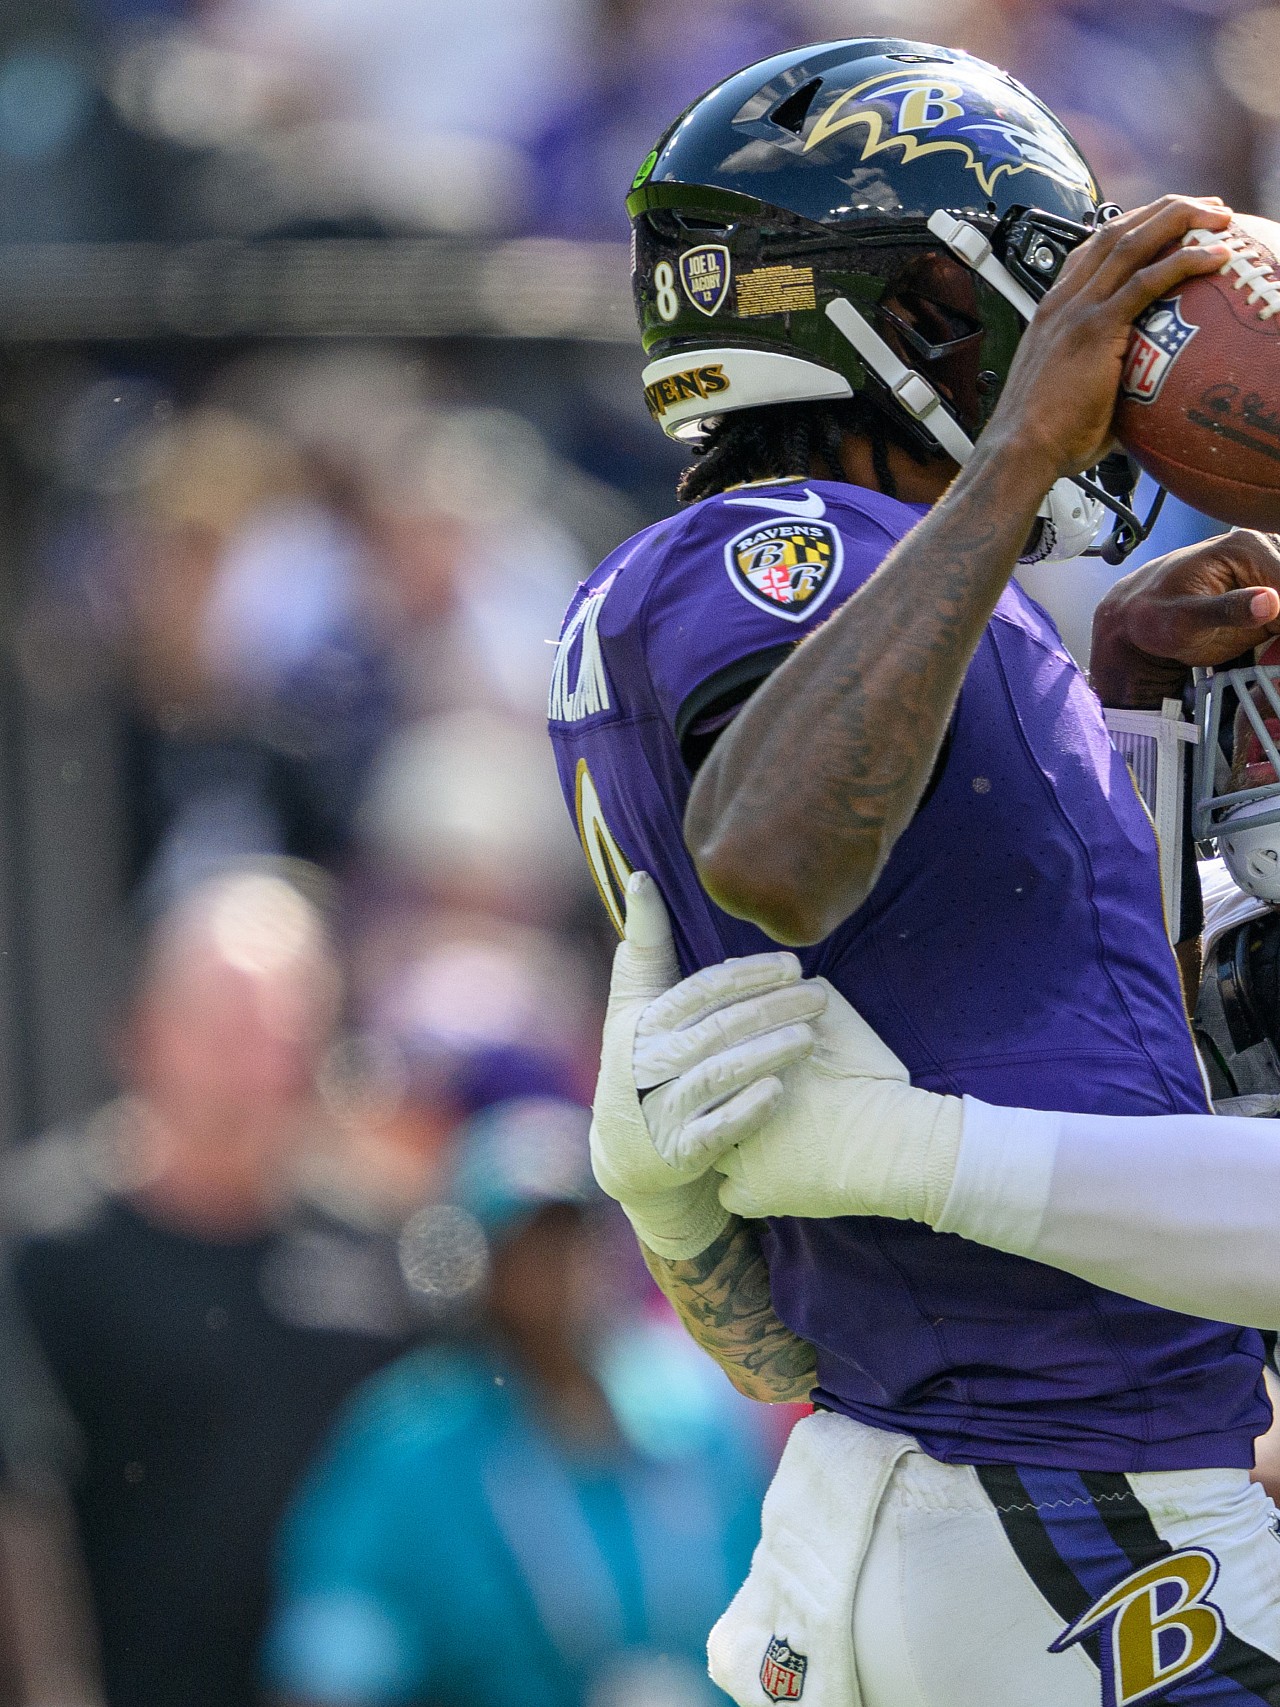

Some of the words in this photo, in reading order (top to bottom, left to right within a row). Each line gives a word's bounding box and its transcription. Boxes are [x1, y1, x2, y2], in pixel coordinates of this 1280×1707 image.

[862, 79, 965, 133] B
[689, 254, 707, 277] JOE
[706, 253, 720, 272] D.
[691, 273, 721, 293] JACOBY
[654, 260, 679, 322] 8
[1122, 329, 1162, 393] FL
[643, 364, 731, 421] VENS
[737, 526, 825, 551] RAVENS
[741, 541, 787, 573] B
[1046, 1546, 1226, 1707] B
[762, 1657, 799, 1697] NFL
